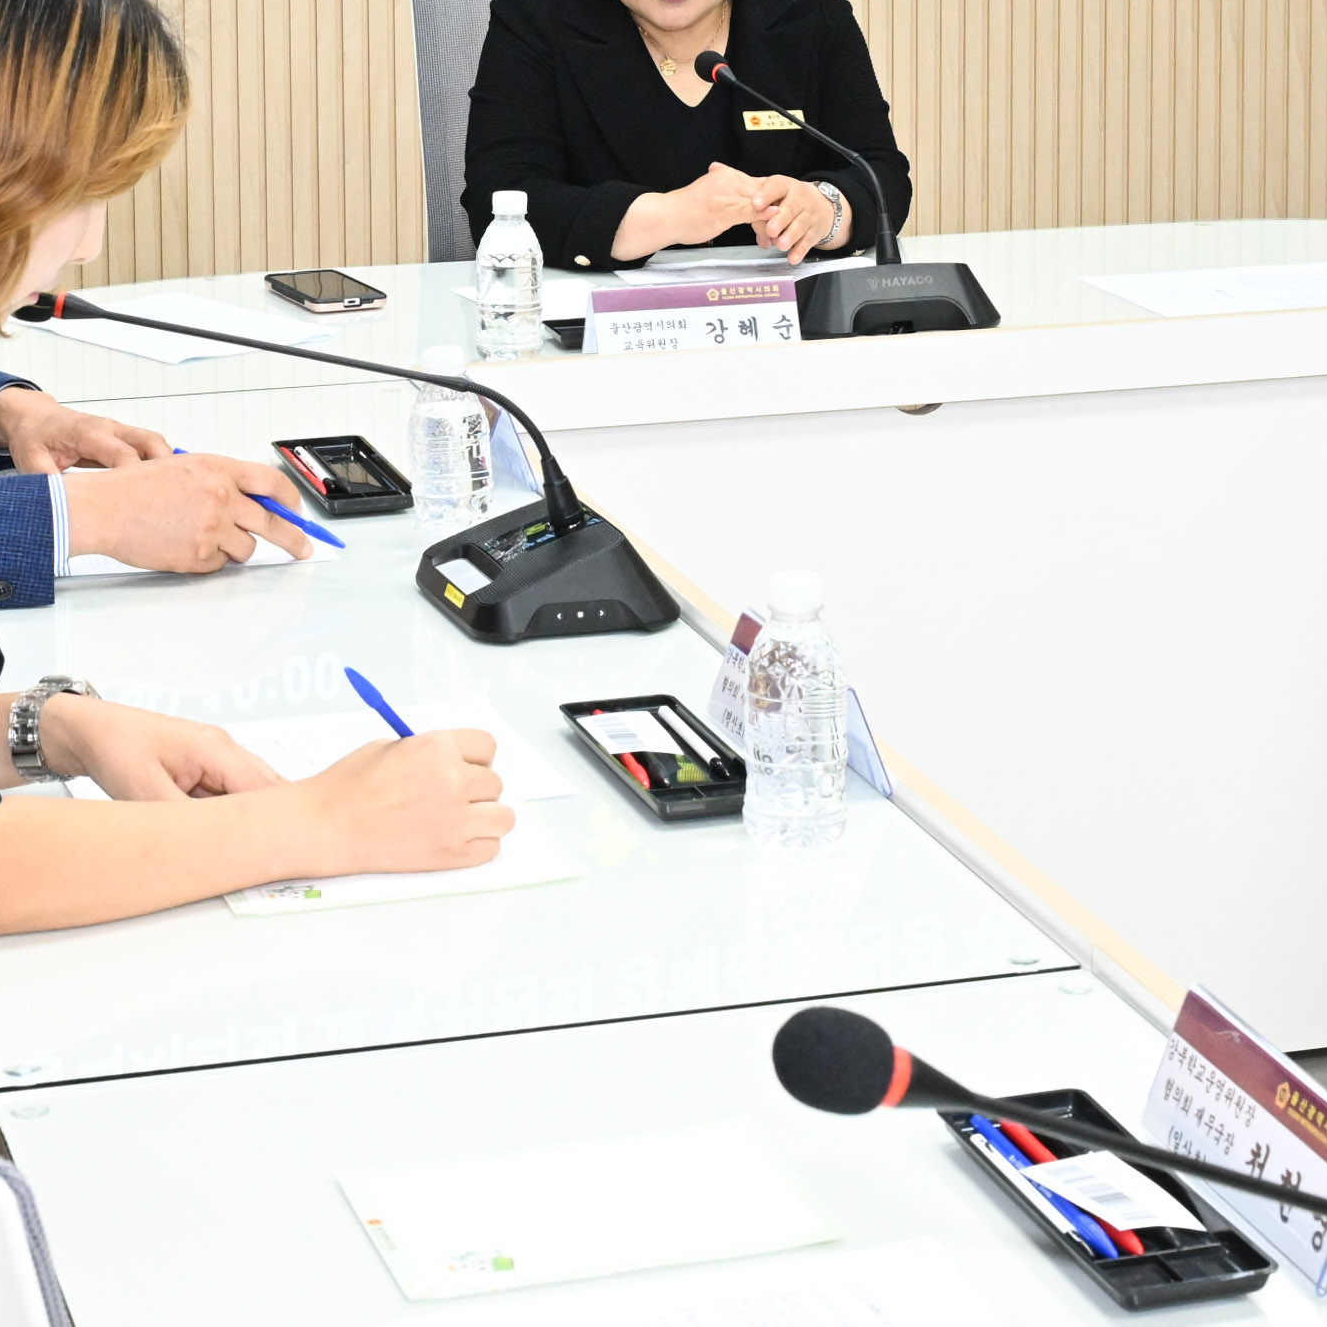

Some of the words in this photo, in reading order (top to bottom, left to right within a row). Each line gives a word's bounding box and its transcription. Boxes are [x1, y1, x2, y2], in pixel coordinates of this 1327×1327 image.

[881, 276, 933, 288] HAYACO
[609, 318, 687, 335] 울산광역시의회
[623, 337, 679, 351] 교육위원장
[1168, 1039, 1256, 1128] 강북학교운영위원장
[1163, 1078, 1193, 1117] 협의회
